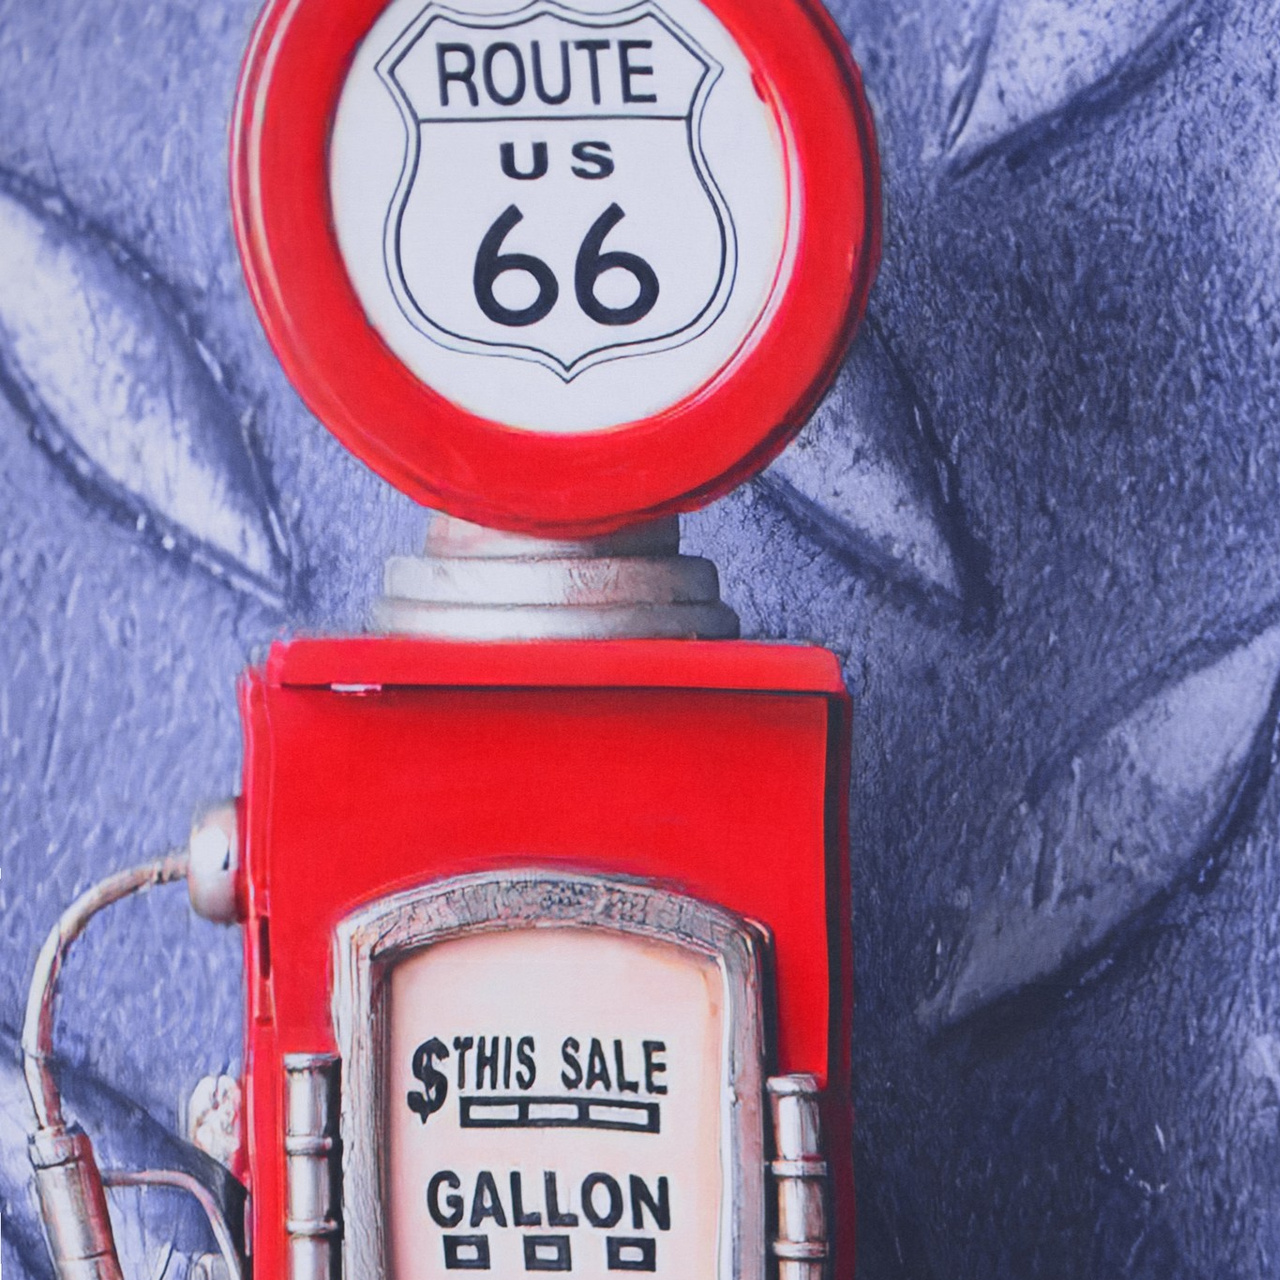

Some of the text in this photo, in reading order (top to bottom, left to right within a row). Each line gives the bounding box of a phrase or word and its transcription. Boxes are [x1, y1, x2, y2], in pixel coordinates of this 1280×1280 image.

[435, 39, 658, 107] ROUTE
[473, 202, 660, 327] 66
[561, 1036, 668, 1095] SALE
[427, 1170, 671, 1231] GALLON
